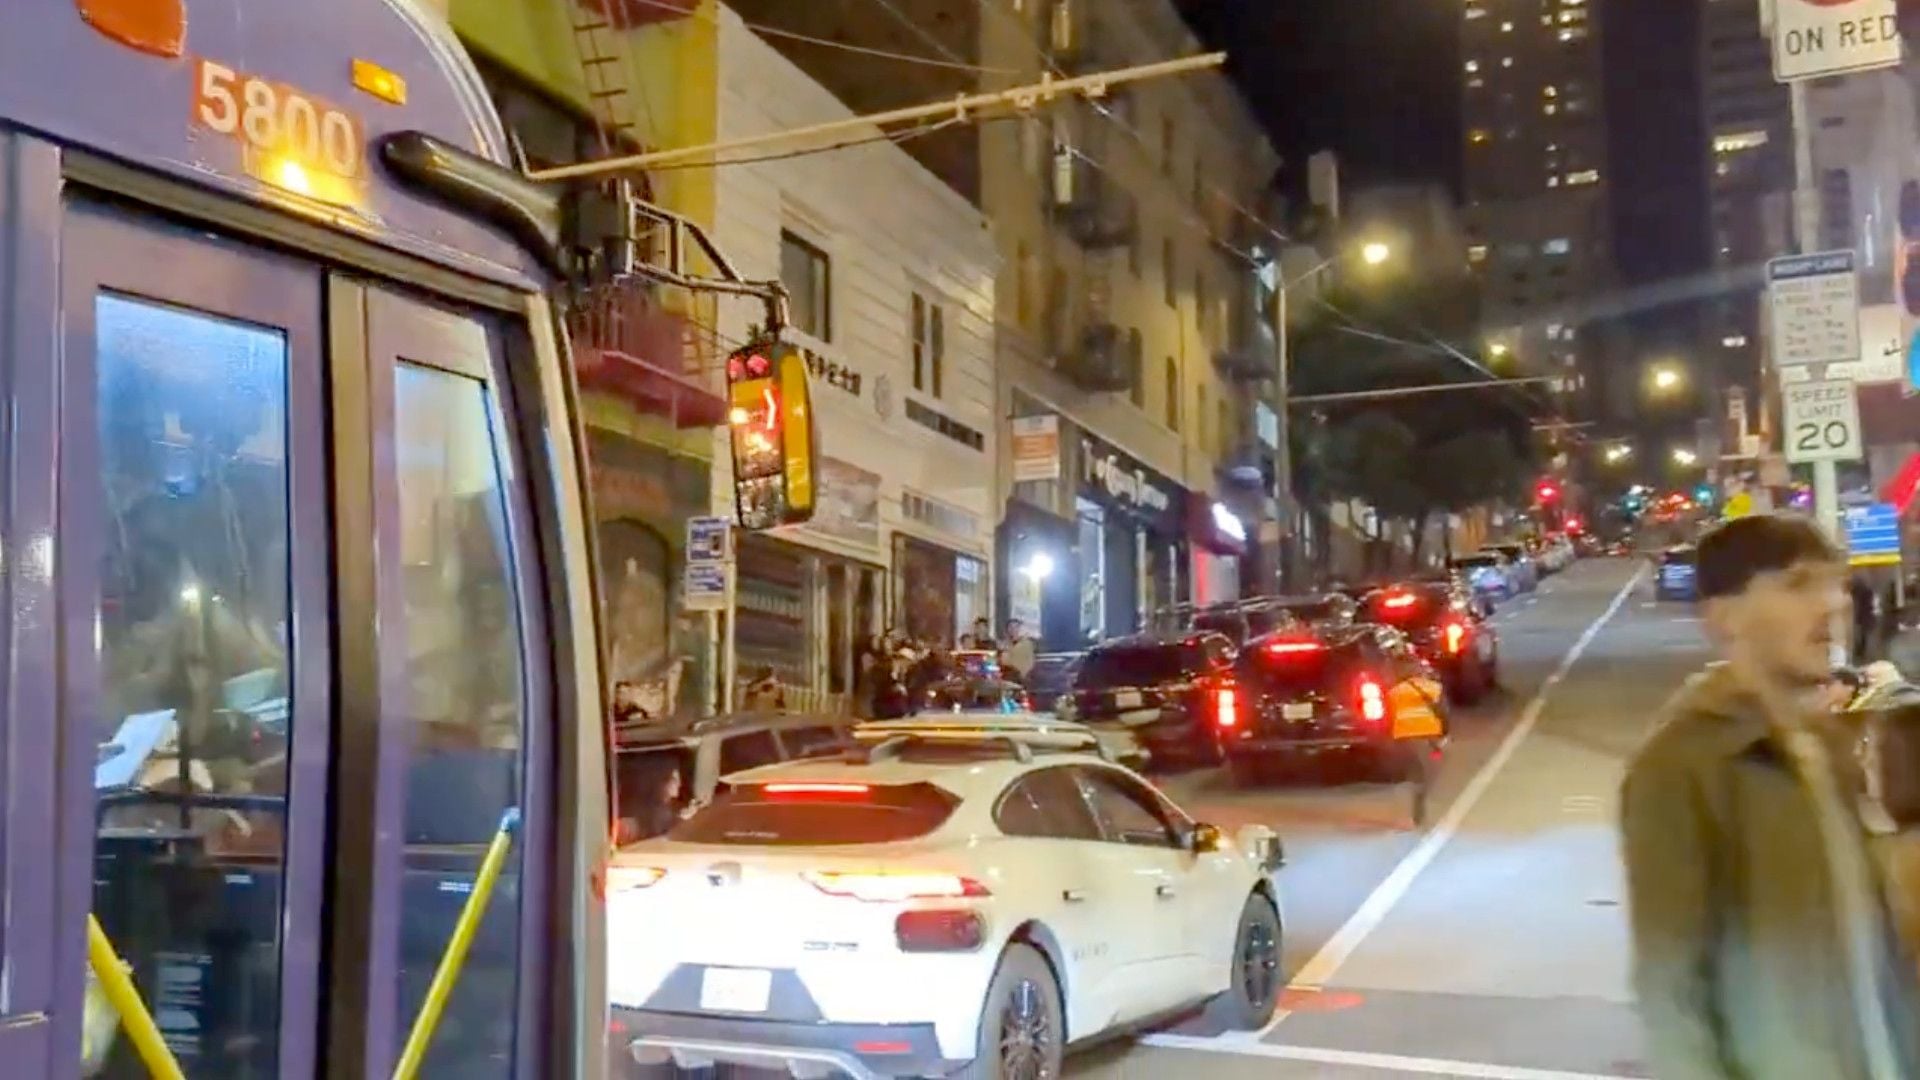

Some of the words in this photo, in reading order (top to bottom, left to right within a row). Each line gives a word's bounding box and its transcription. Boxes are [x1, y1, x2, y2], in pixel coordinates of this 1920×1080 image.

[1785, 27, 1824, 56] ON
[1839, 14, 1899, 47] RED
[200, 60, 357, 177] 5800
[1791, 388, 1848, 402] SPEED
[1796, 403, 1842, 419] LIMIT
[1796, 421, 1849, 451] 20
